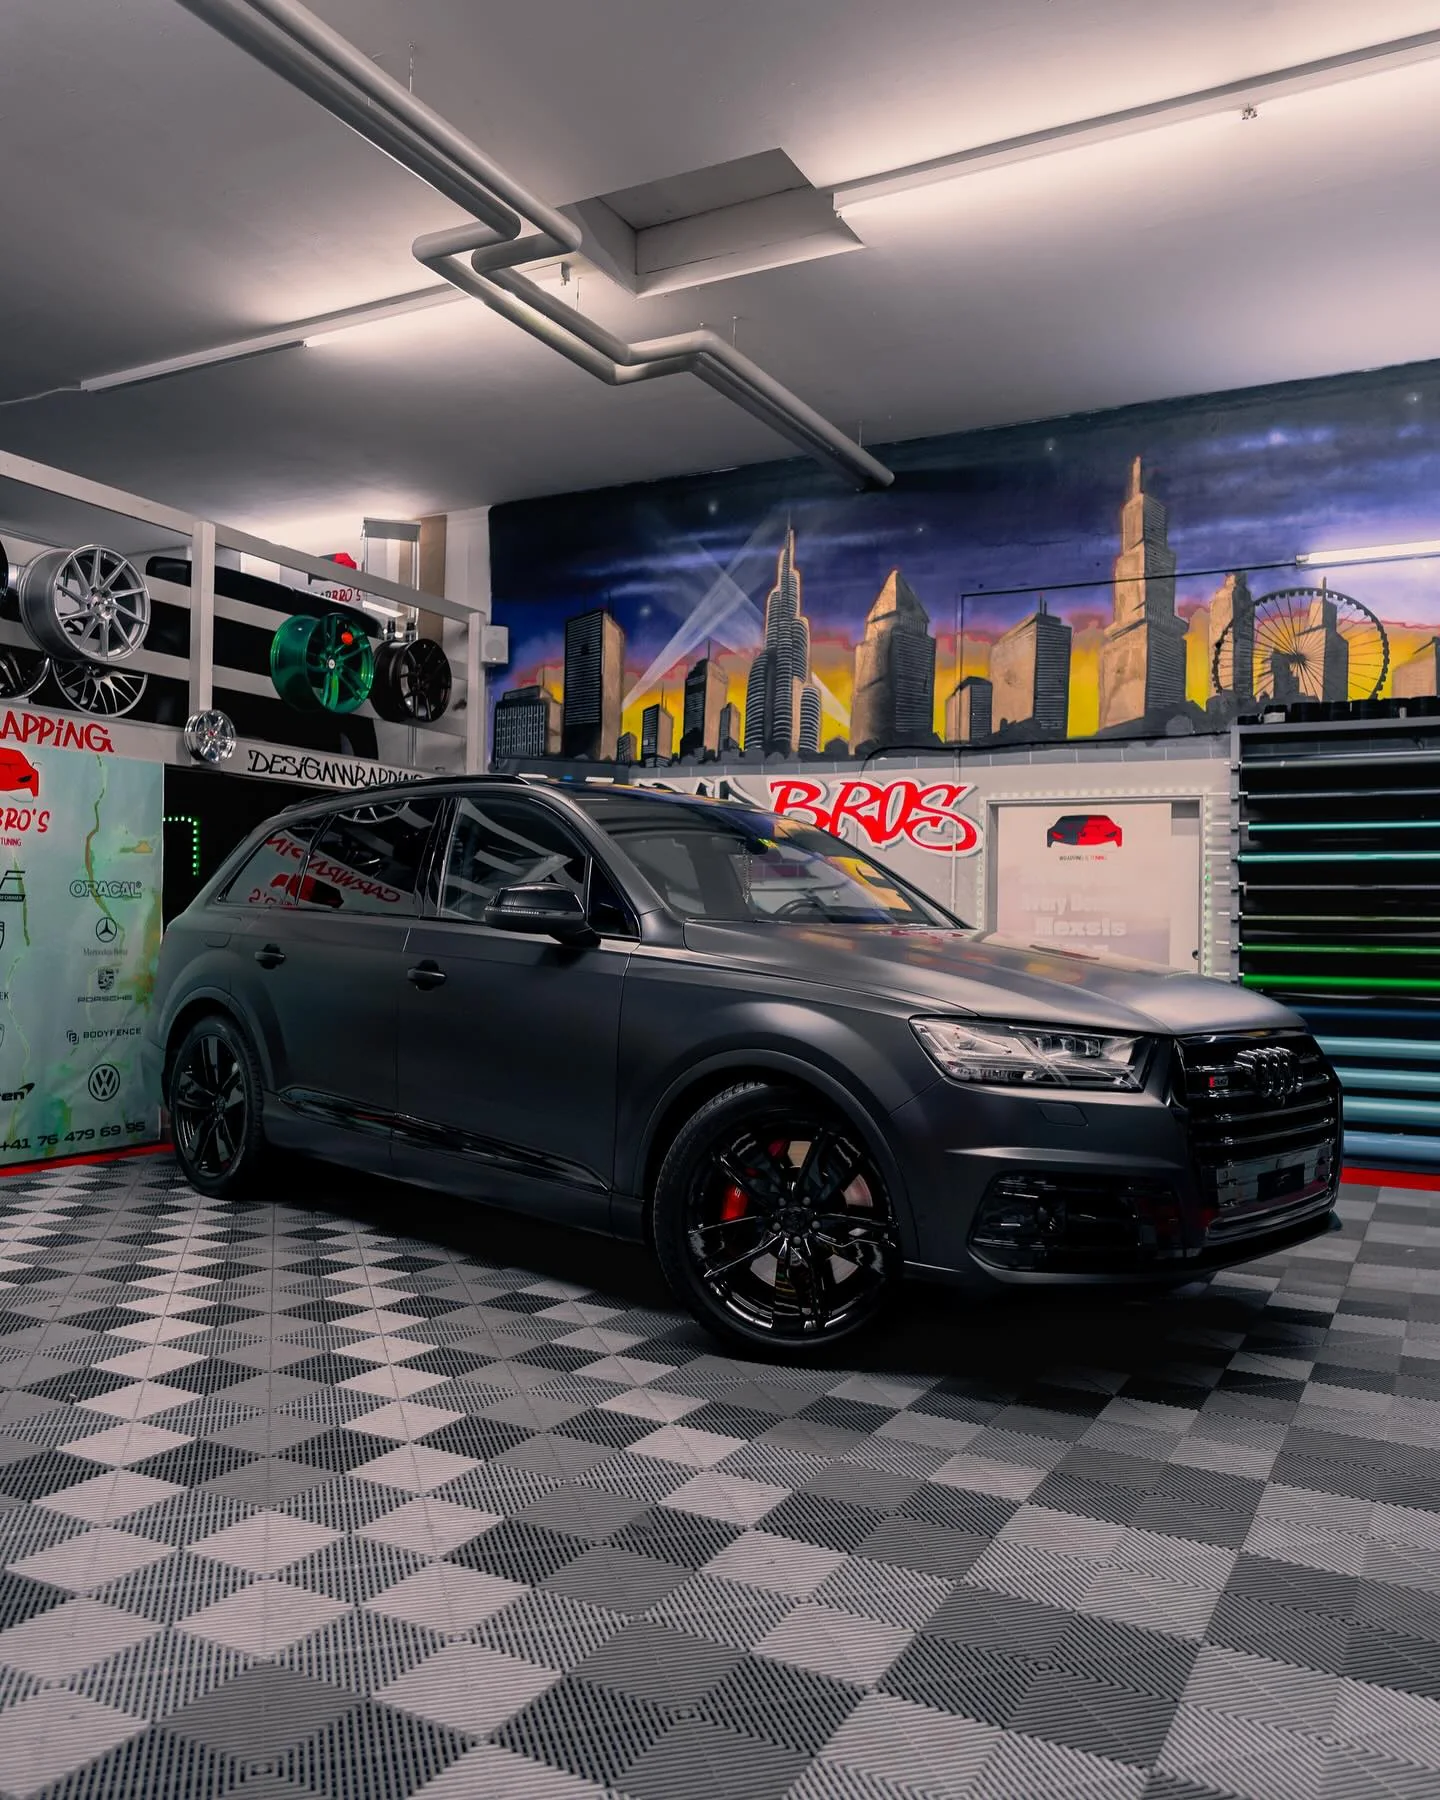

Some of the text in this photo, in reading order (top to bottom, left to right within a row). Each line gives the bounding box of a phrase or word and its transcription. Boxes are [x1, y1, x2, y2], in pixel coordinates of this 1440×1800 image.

[0, 711, 114, 753] APPiNG
[0, 807, 50, 833] RO'S
[768, 778, 978, 852] BROS
[83, 1027, 141, 1039] BODYFENCE
[1, 1122, 145, 1150] +41 76 479 69 95
